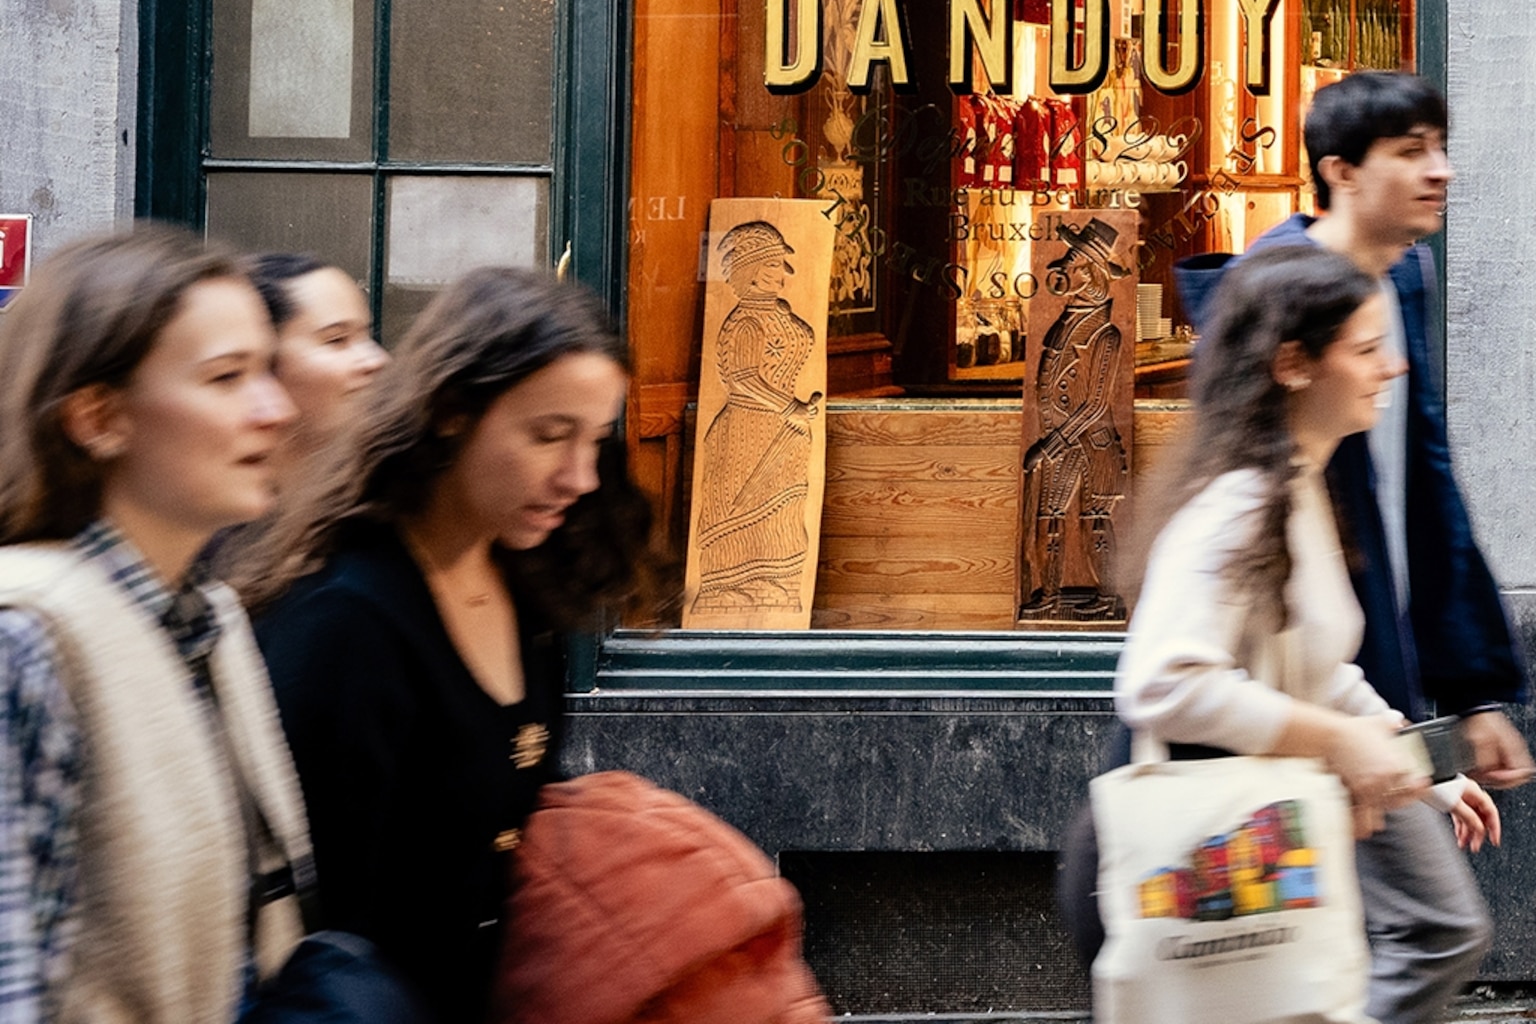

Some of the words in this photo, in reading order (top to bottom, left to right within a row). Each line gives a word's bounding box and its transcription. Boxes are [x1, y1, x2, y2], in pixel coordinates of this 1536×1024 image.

[1050, 114, 1203, 167] 1829
[903, 177, 969, 208] Rue
[979, 187, 1016, 207] au
[1029, 179, 1141, 208] Beurre
[990, 116, 1277, 300] SPECTACOOS
[946, 214, 1093, 242] Bruxelle
